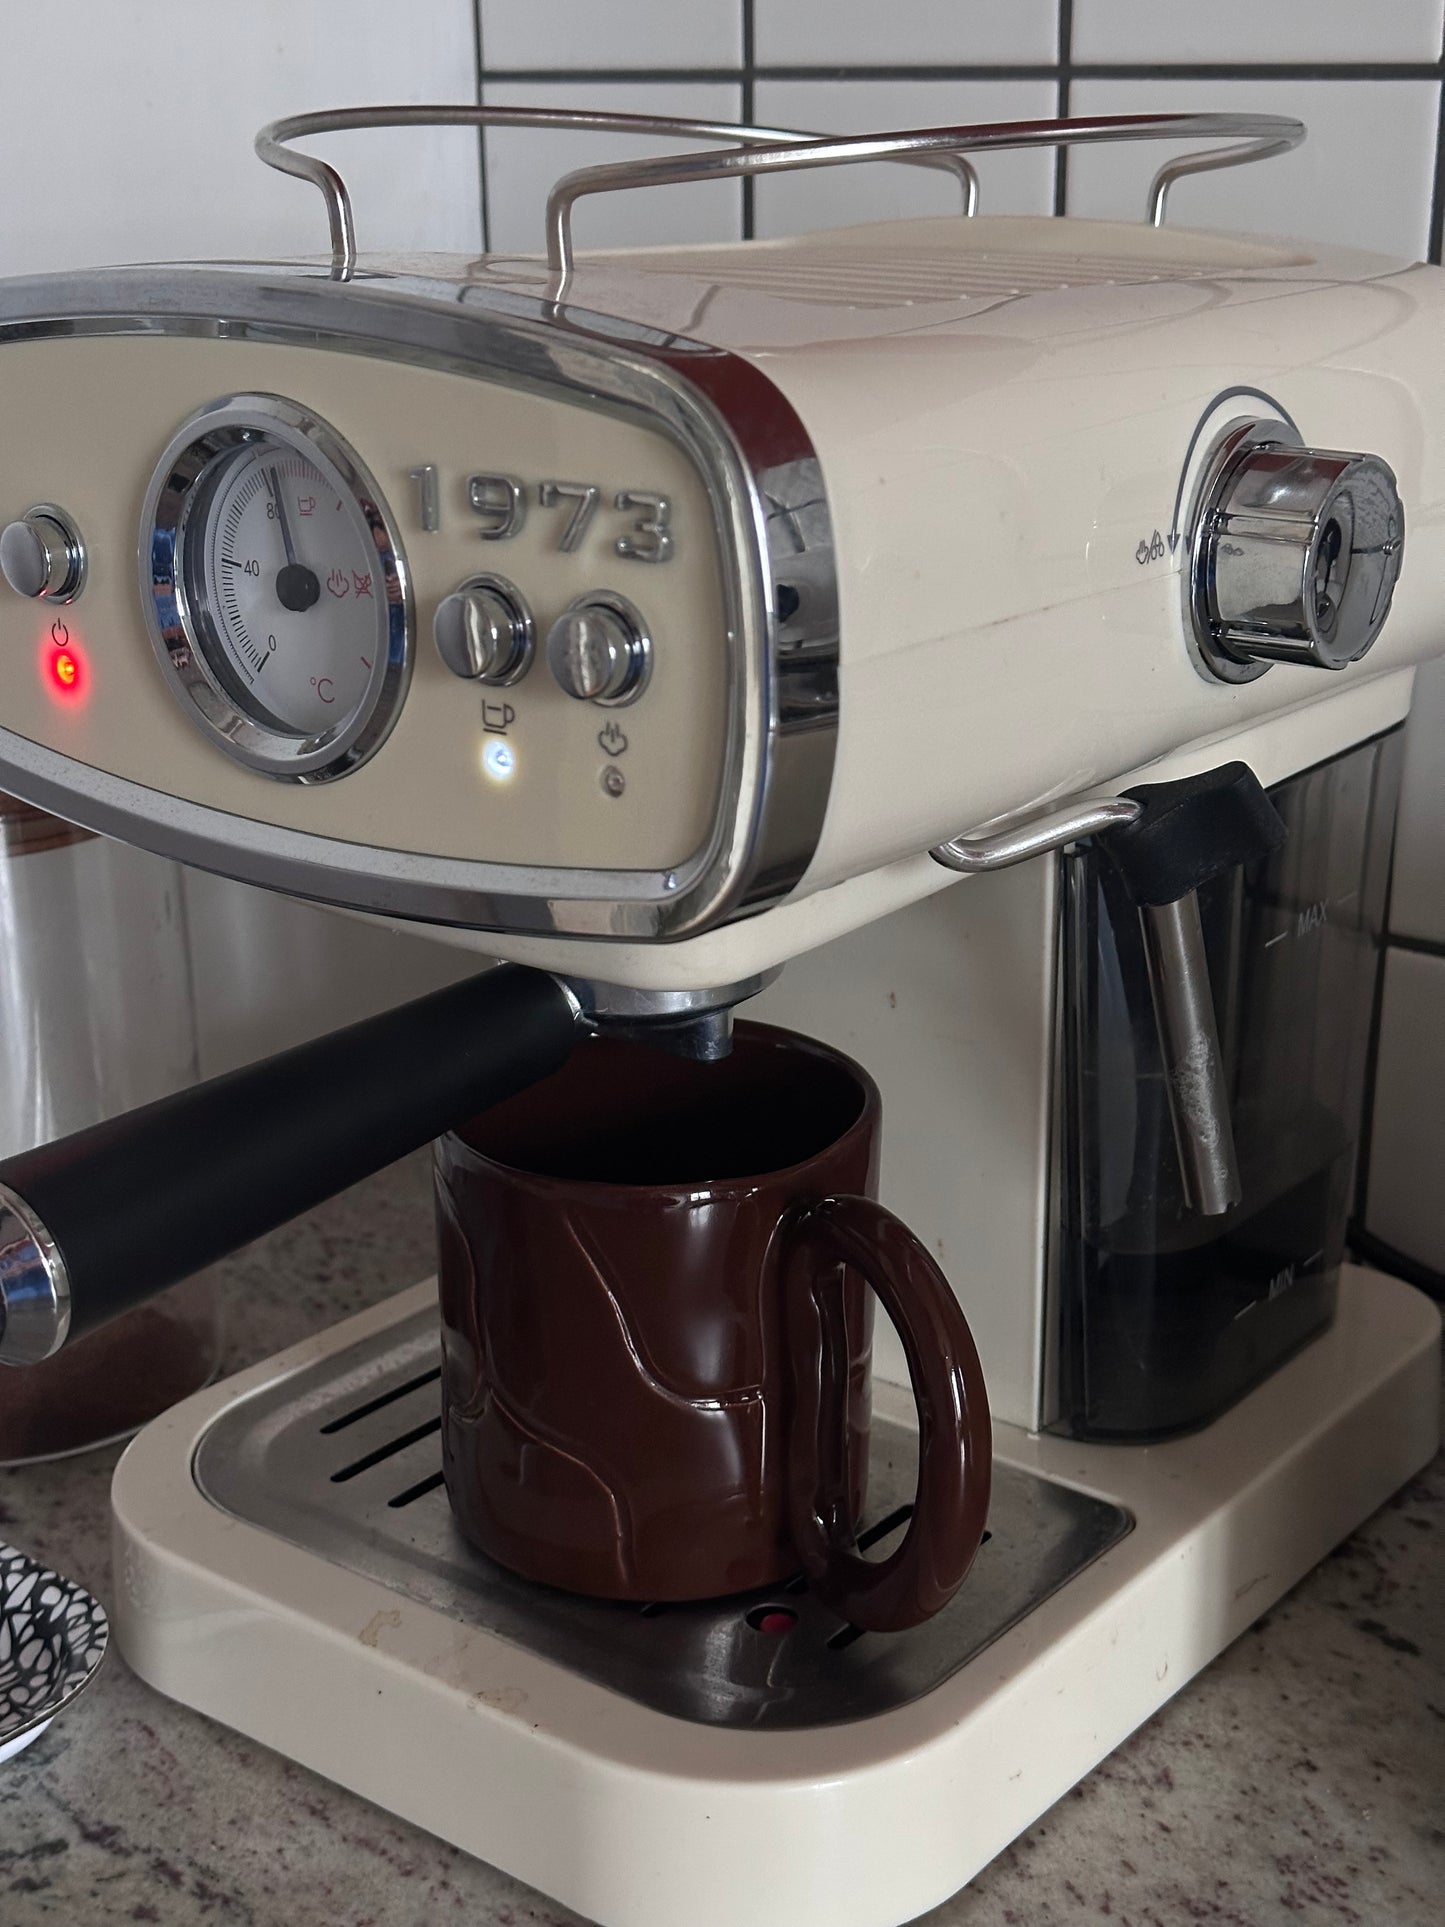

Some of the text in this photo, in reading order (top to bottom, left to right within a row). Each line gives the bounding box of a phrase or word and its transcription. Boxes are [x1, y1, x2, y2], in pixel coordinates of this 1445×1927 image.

[408, 464, 674, 563] 1973
[244, 560, 260, 577] 40
[268, 634, 277, 651] 0
[1298, 900, 1329, 937] MAX
[1269, 1263, 1295, 1301] MIN
